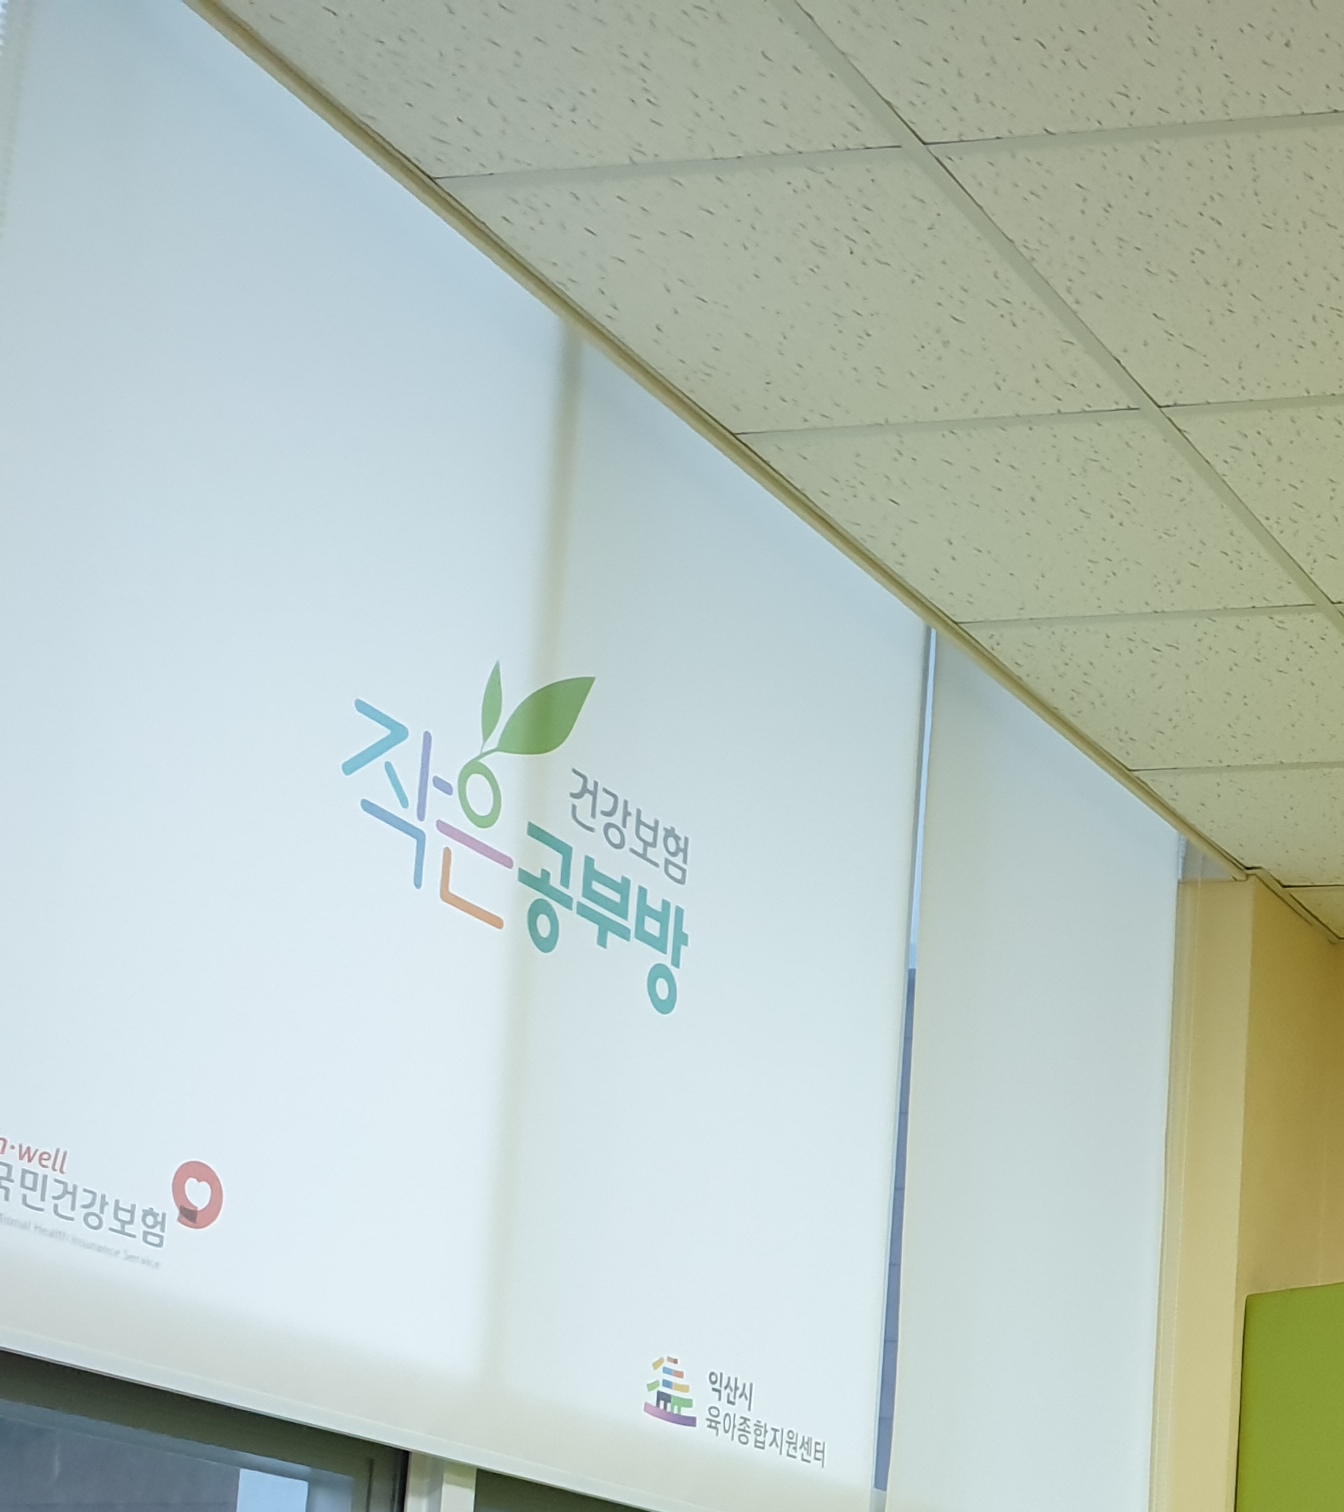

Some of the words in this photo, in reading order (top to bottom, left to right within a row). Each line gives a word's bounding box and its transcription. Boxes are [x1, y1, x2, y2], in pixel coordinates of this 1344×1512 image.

[341, 698, 514, 930] 작은
[569, 767, 690, 886] 건강보험
[517, 821, 690, 1015] 공부방
[705, 1405, 826, 1469] 육아종합지원센터
[708, 1371, 754, 1412] 익산시
